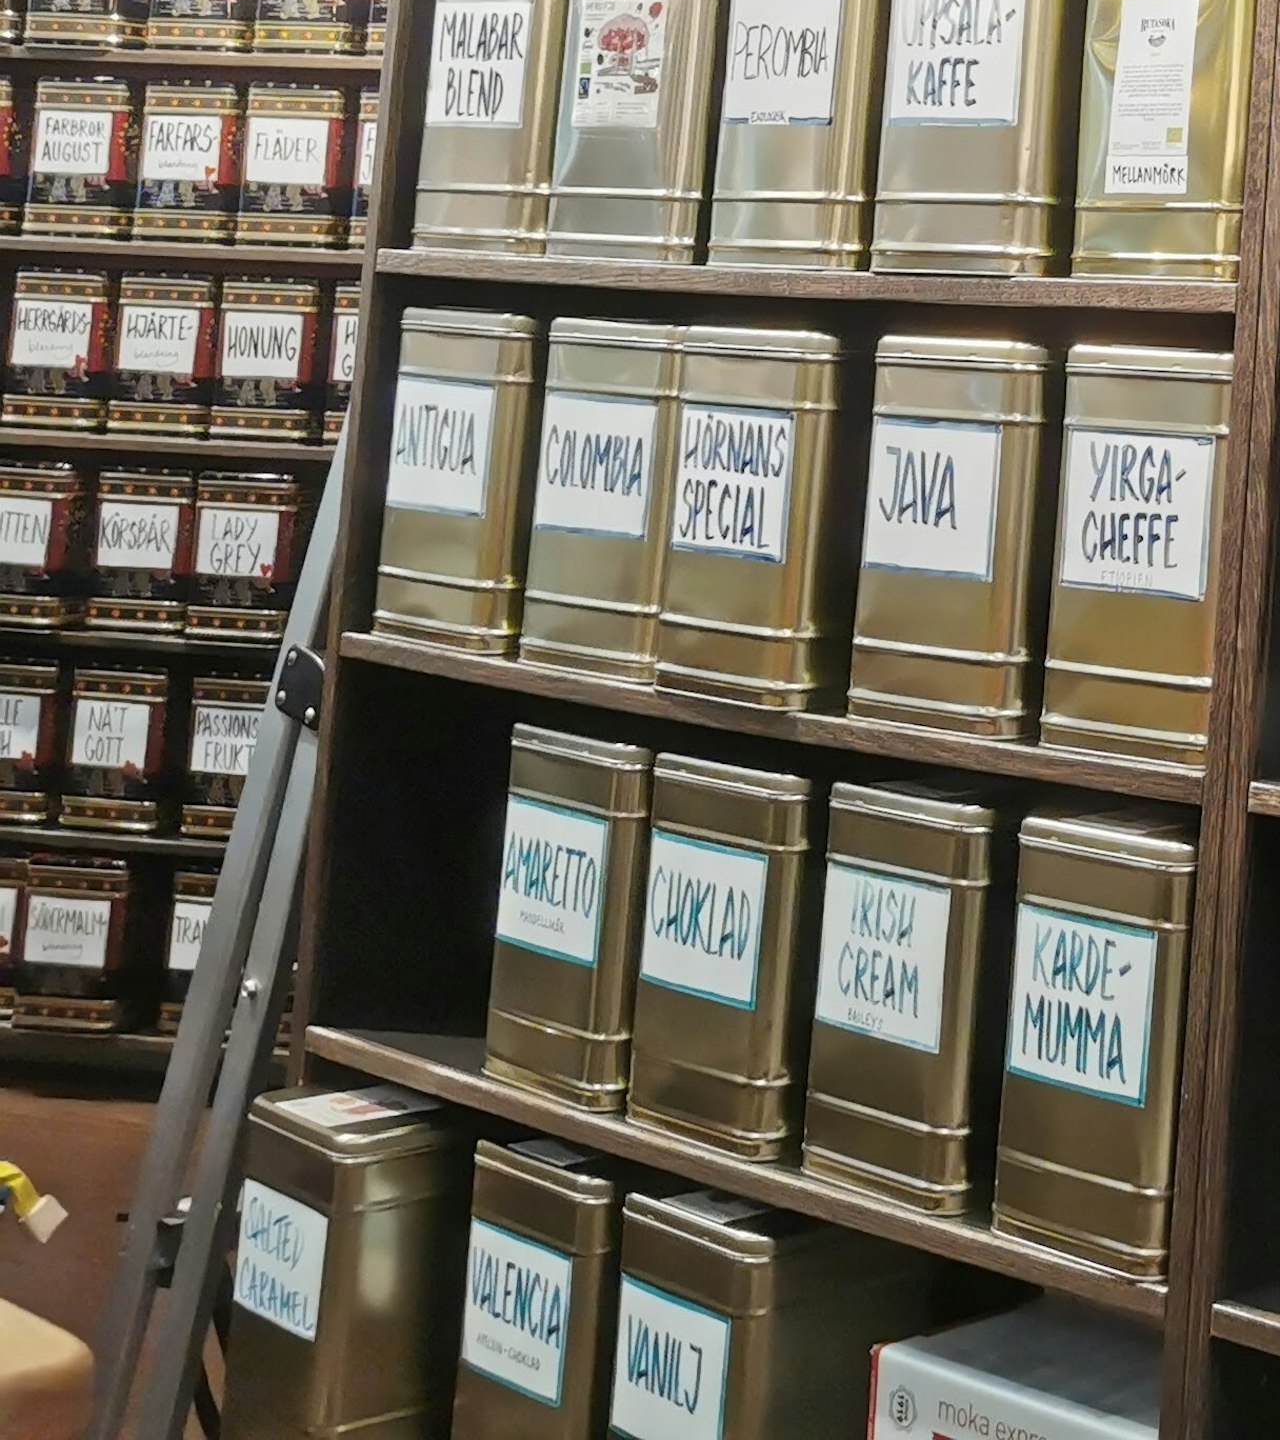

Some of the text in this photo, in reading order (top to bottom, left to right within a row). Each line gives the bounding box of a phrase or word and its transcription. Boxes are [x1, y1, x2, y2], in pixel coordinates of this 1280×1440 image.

[442, 12, 524, 65] MALABAR
[733, 21, 829, 82] PEROMBIA
[444, 69, 504, 120] BLEND
[907, 57, 978, 107] KAFFE
[41, 140, 104, 164] AUGUST
[45, 116, 106, 141] FARBROR
[254, 129, 319, 164] FLÄDER
[1112, 163, 1186, 186] MELLANMÖRK
[227, 325, 298, 362] HONUNG
[394, 404, 477, 477] ANTIGUA
[544, 431, 645, 497] COLOMBIA
[682, 411, 788, 478] HÖRNANS
[878, 446, 958, 532] JAVA
[1089, 440, 1188, 505] YIRGA-
[211, 515, 258, 540] LADY
[679, 481, 771, 551] SPECIAL
[1081, 511, 1180, 570] CHEFFE
[210, 543, 261, 573] GREY
[84, 735, 124, 764] GOTT
[196, 711, 259, 739] PASSIONS
[204, 740, 255, 771] FRUKT
[502, 830, 598, 920] AMARETTO
[649, 864, 753, 962] CHOKLAD
[849, 874, 917, 948] IRISH
[837, 943, 920, 1019] CREAM
[1031, 920, 1133, 1002] KARDE-
[1021, 997, 1127, 1085] MUMMA
[238, 1257, 315, 1333] CARAMEL
[471, 1246, 562, 1350] VALENCIA
[625, 1317, 703, 1414] VANILJ
[937, 1400, 990, 1436] moka
